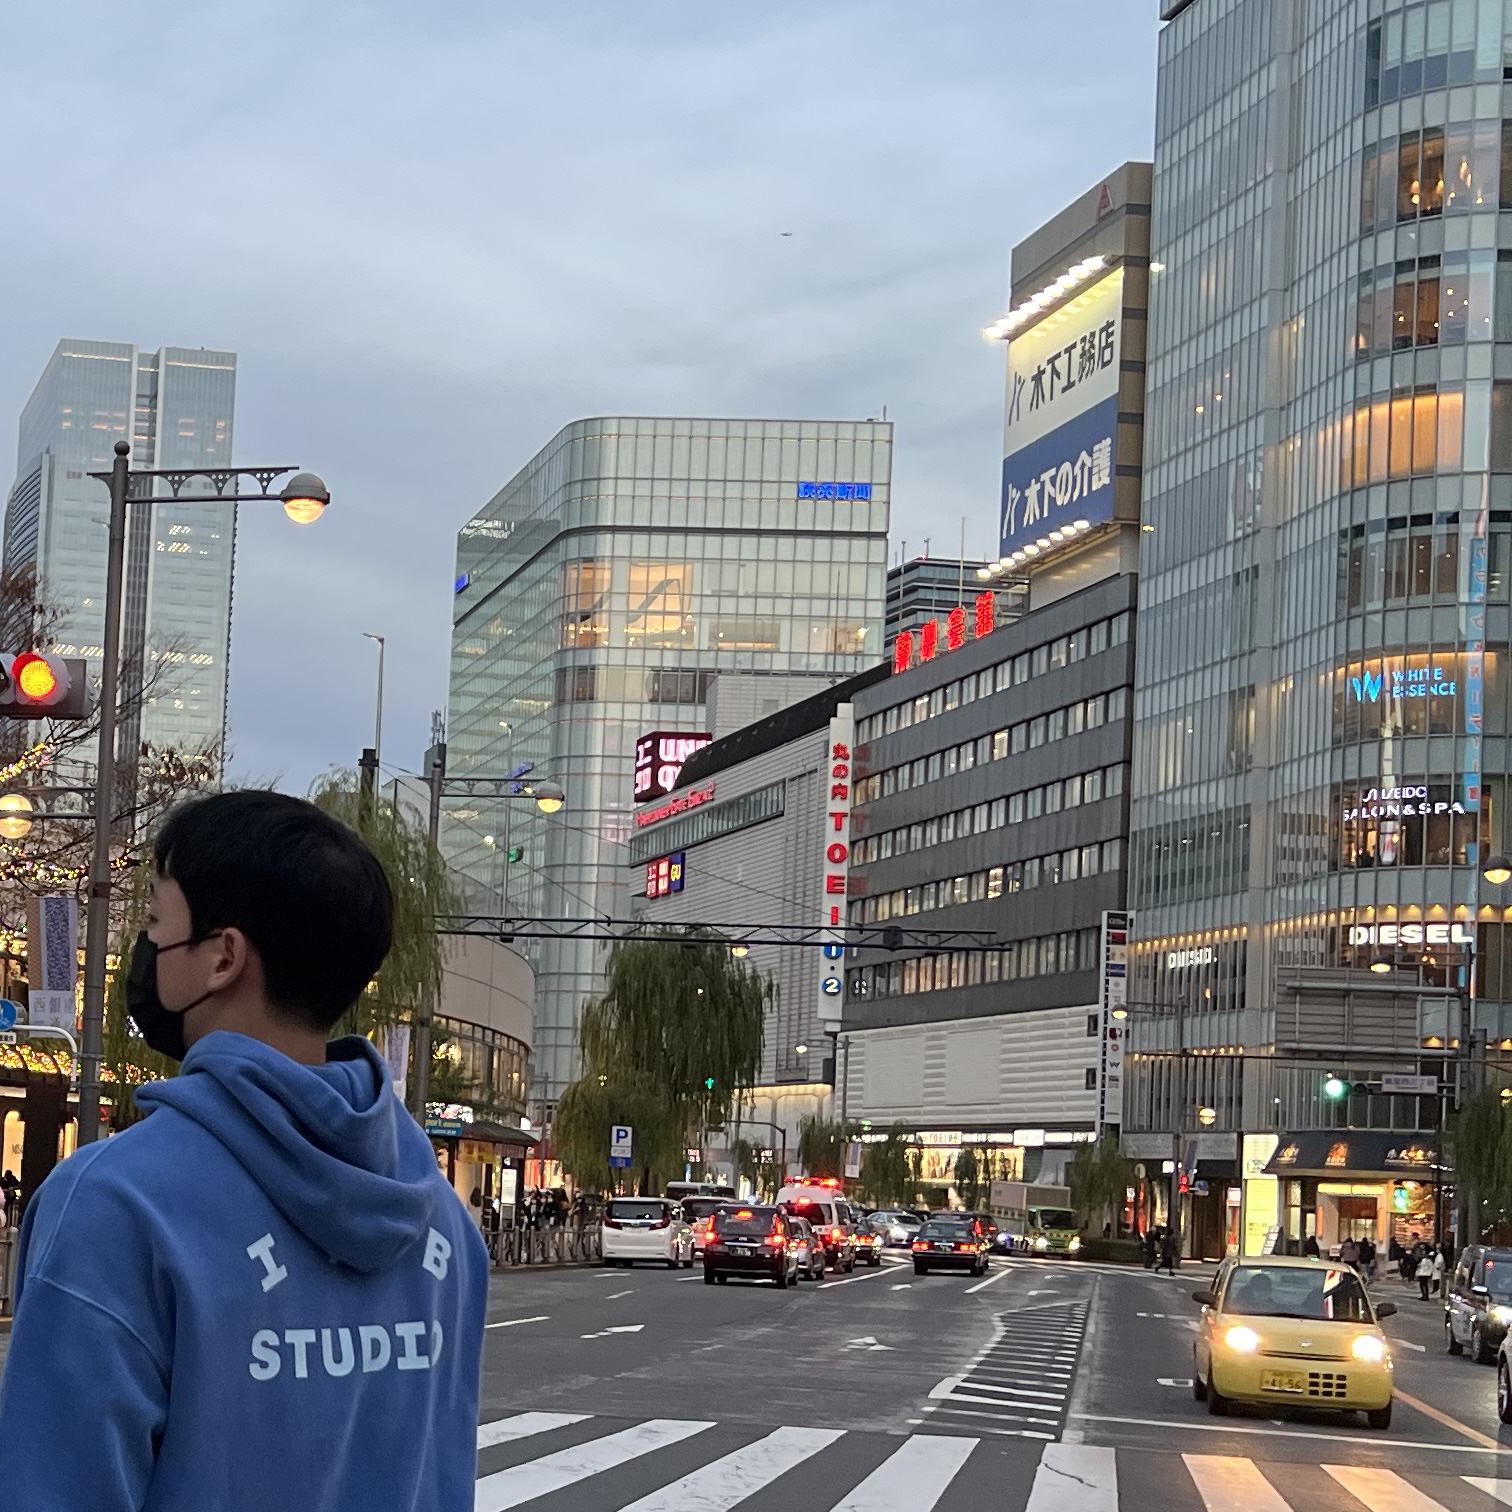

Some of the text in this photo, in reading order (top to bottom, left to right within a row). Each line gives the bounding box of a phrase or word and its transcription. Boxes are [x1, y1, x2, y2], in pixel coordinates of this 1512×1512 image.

[1029, 319, 1116, 412] 木下工務店
[1023, 437, 1112, 528] 木下の介護
[1392, 667, 1442, 682] WHITE
[1348, 924, 1474, 945] DIESEL
[615, 1128, 629, 1144] P
